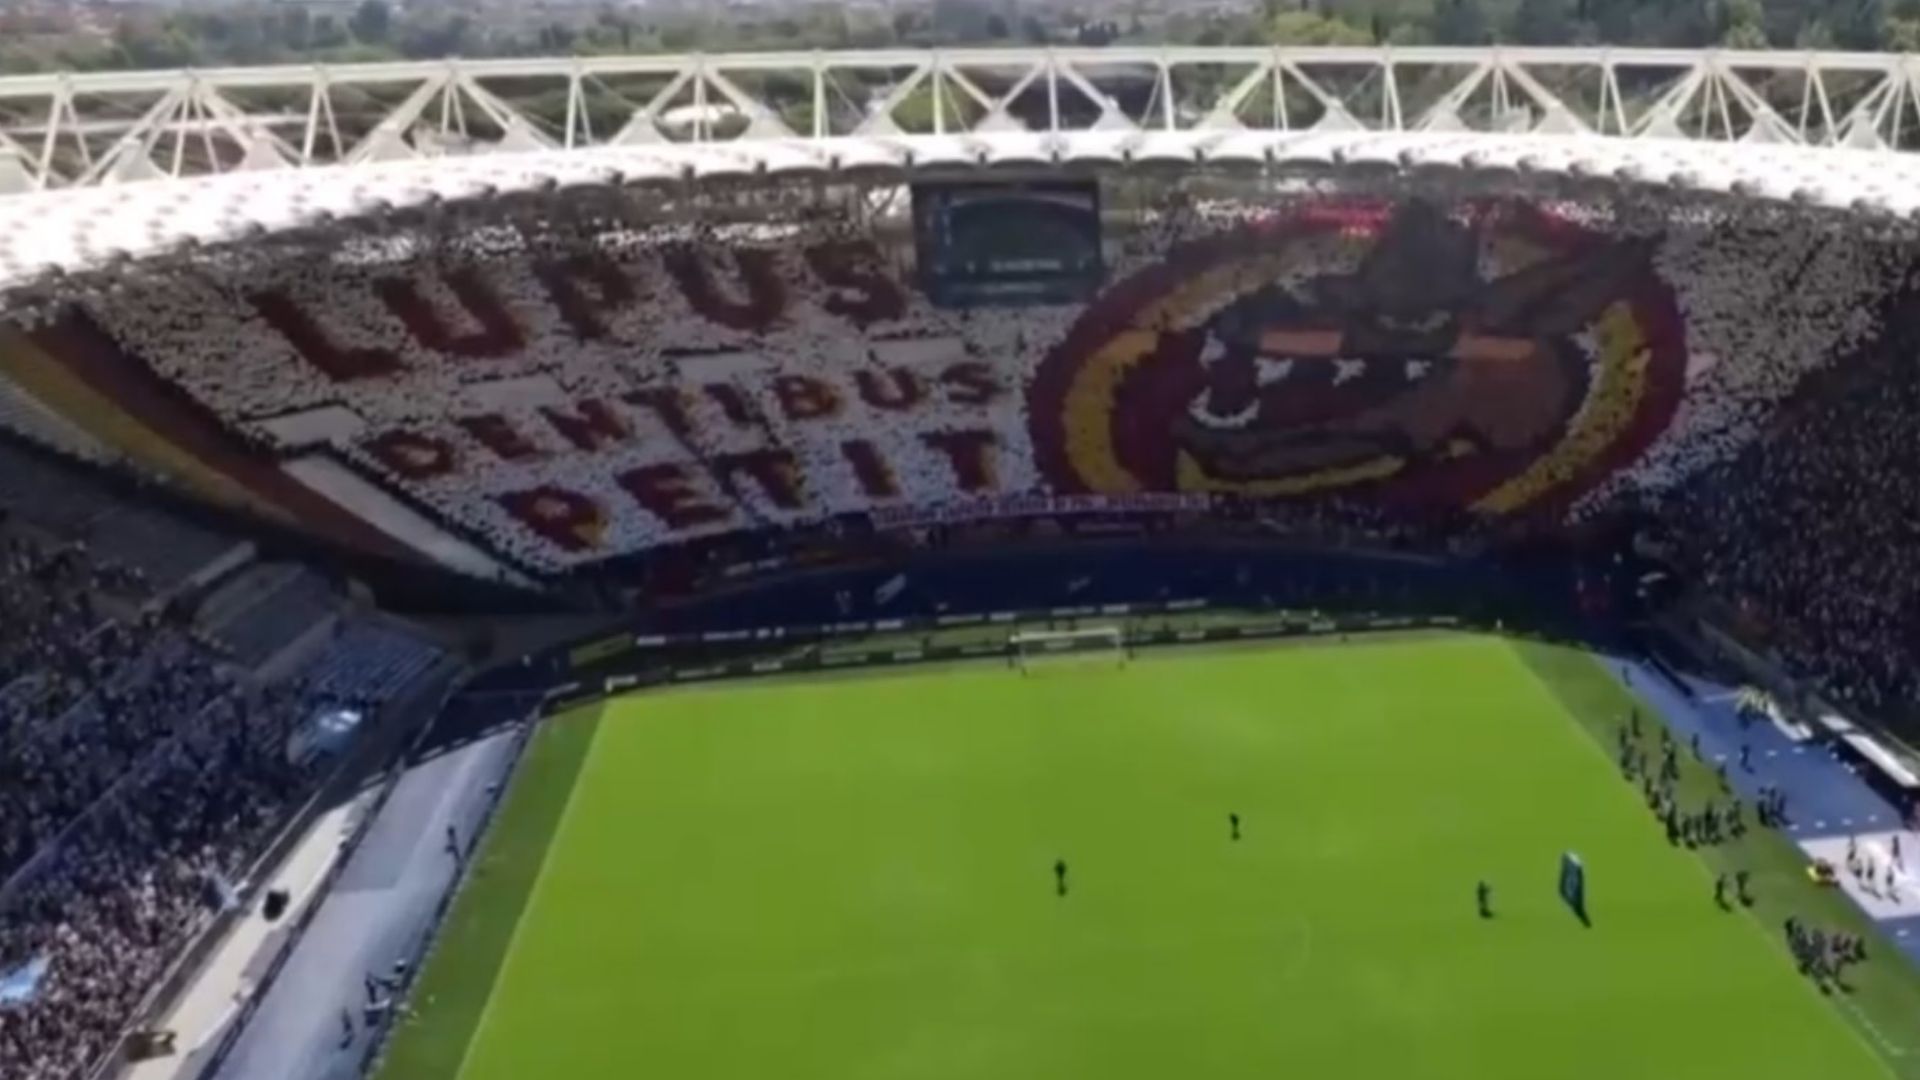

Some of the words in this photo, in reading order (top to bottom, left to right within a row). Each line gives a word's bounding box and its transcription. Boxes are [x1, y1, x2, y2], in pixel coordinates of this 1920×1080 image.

[252, 239, 905, 382] LUPUS
[369, 360, 1005, 478] DENTIBUS
[496, 430, 1001, 553] PETIT
